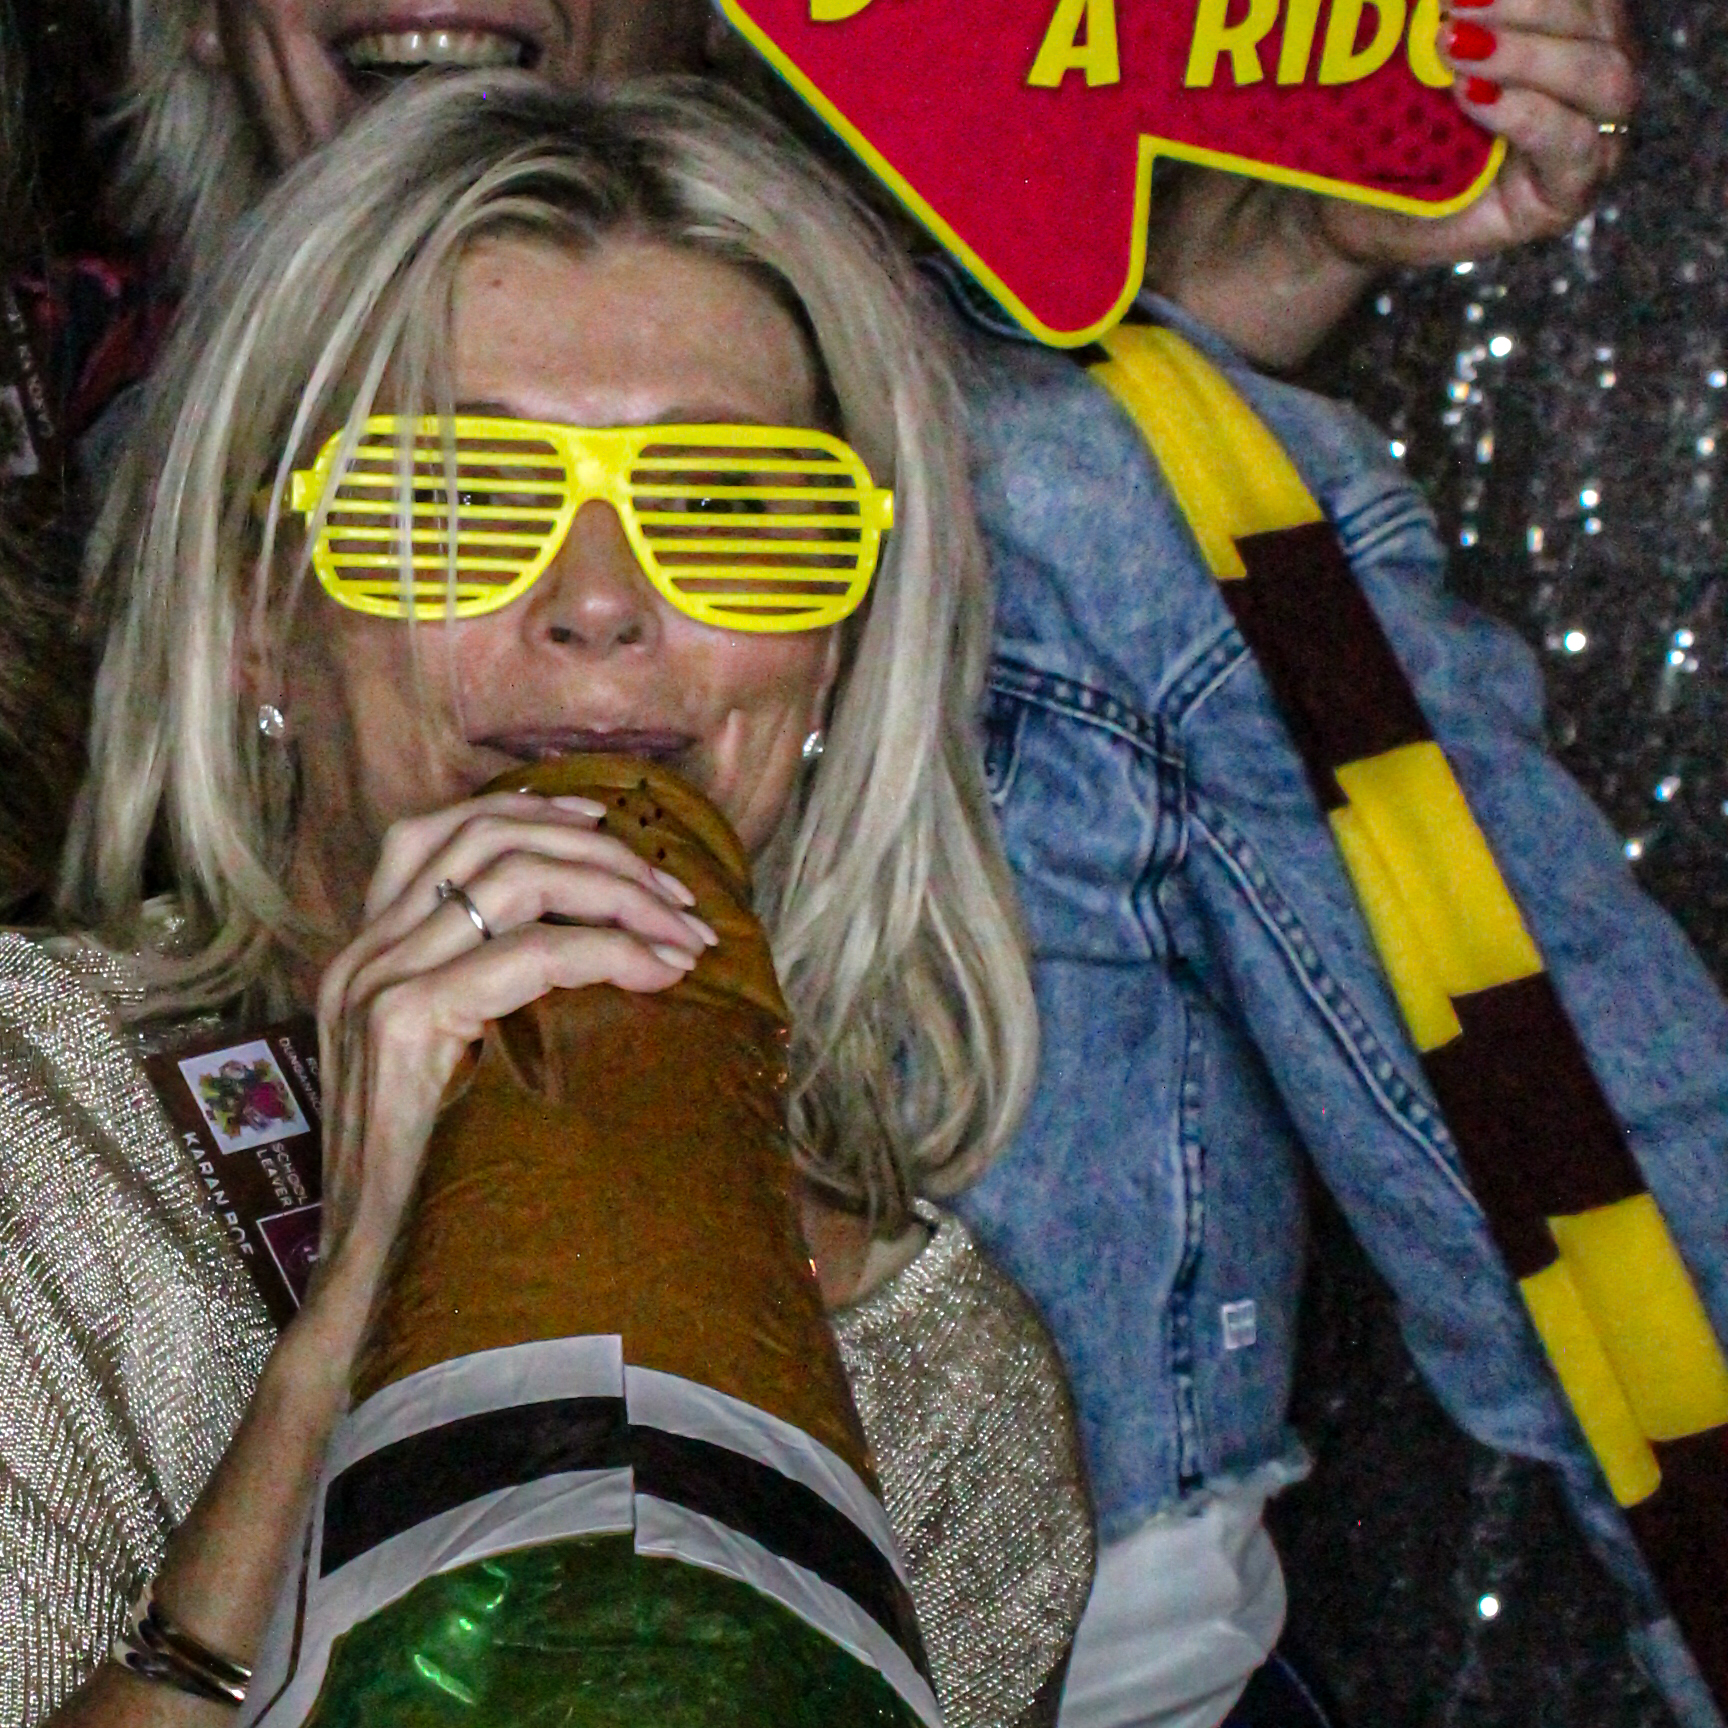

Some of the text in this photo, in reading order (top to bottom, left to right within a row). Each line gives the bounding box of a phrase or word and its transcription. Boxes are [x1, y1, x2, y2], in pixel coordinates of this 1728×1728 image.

[278, 1036, 322, 1115] DUNGANNO
[182, 1131, 230, 1206] KARAN
[256, 1148, 293, 1208] LEAVER
[272, 1141, 308, 1206] SCHOOL
